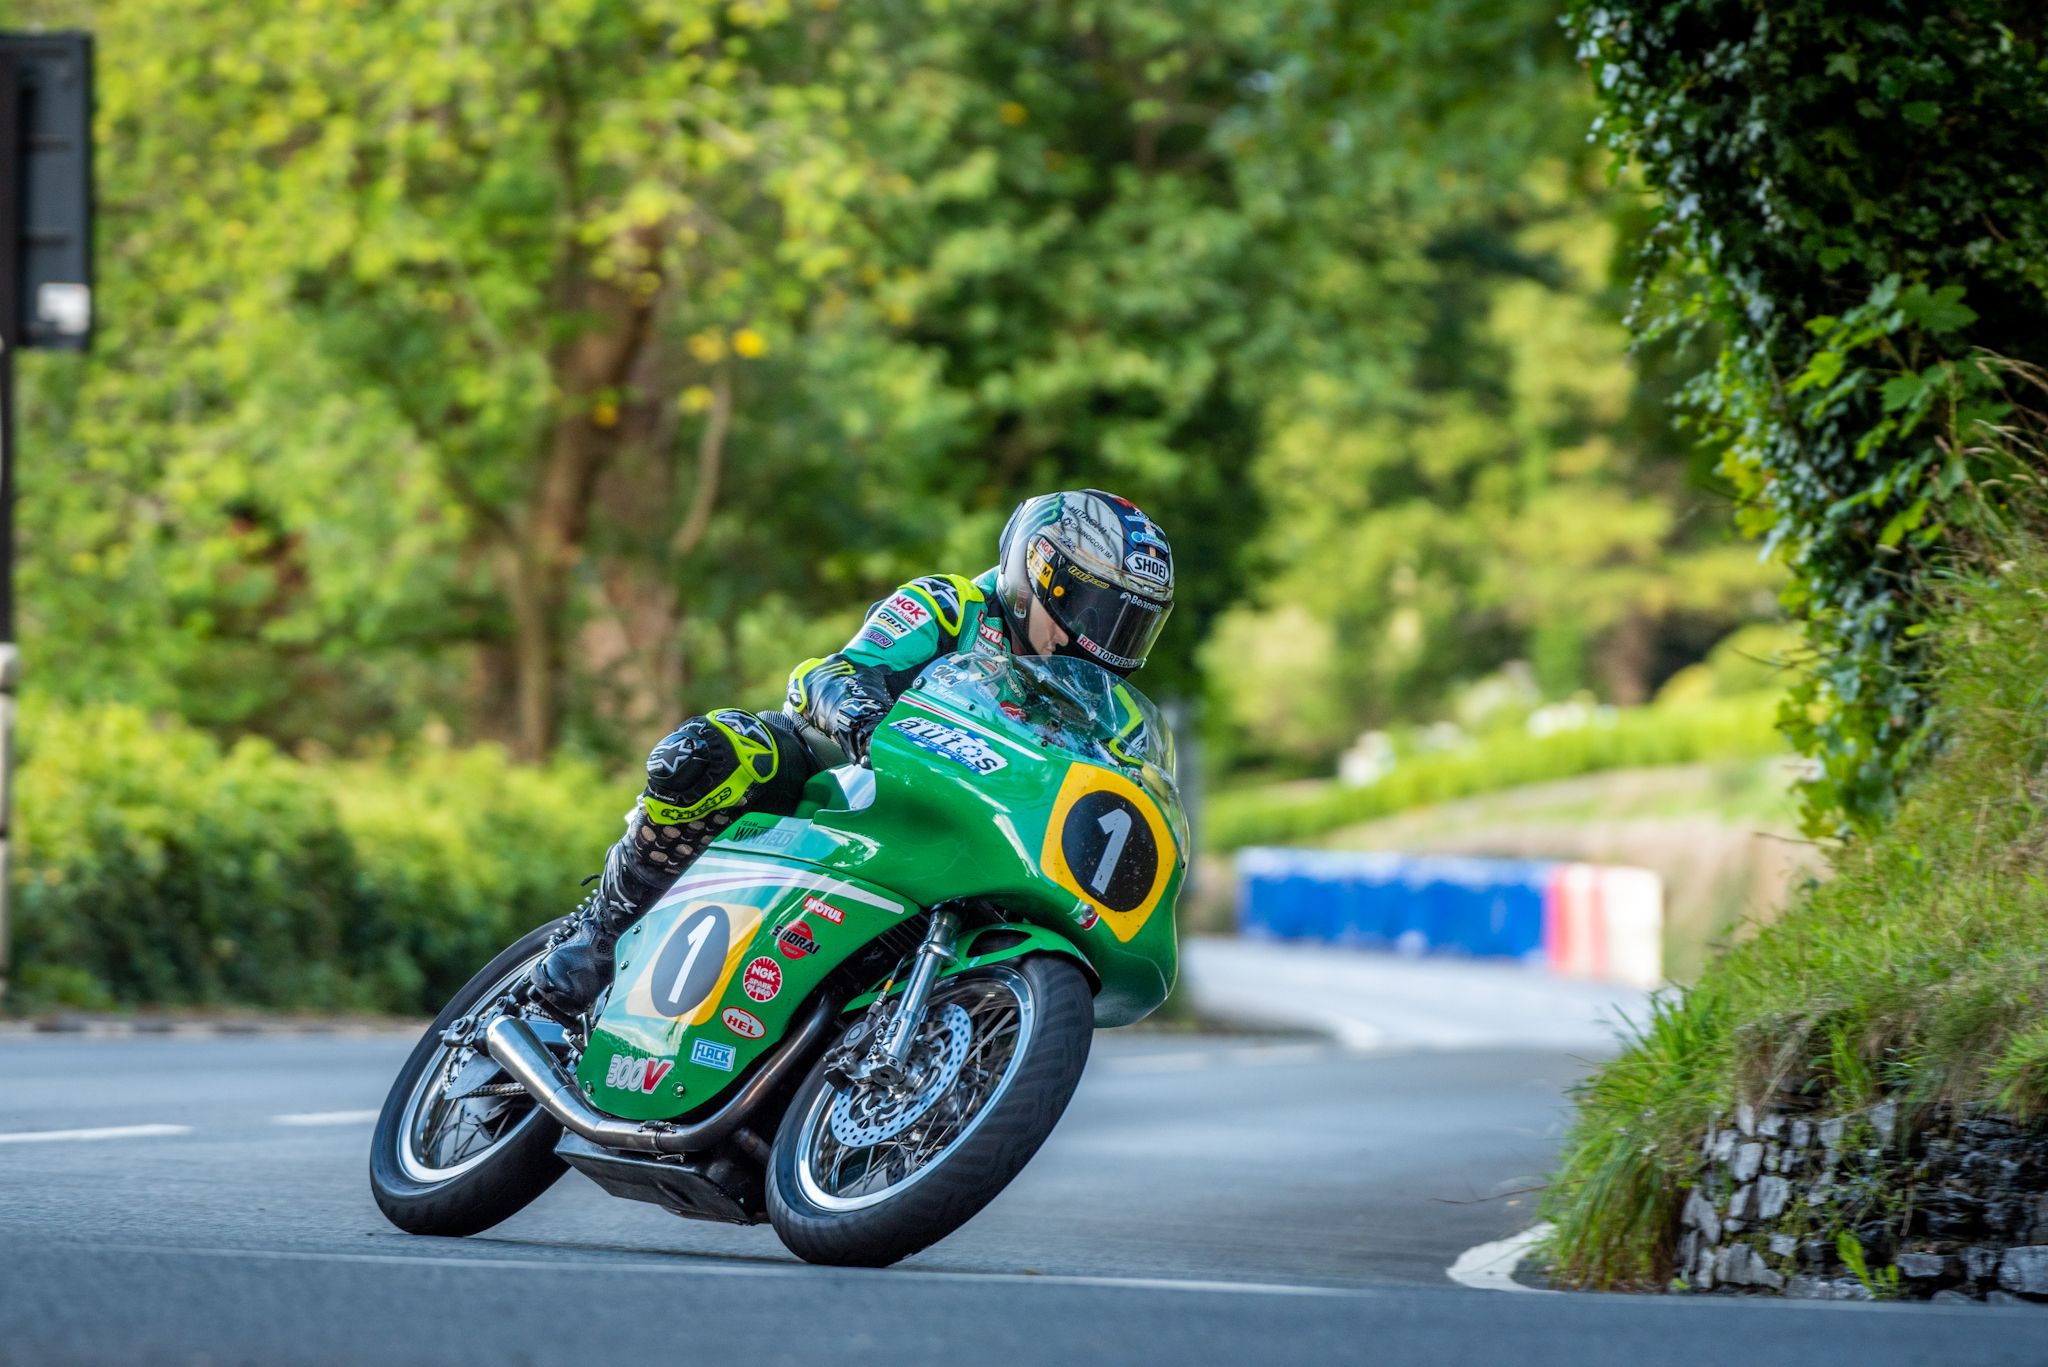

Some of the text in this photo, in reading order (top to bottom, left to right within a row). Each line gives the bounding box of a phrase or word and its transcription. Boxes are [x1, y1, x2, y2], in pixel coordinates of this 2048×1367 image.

[1039, 540, 1055, 558] NGK
[1135, 557, 1165, 580] SHOEI
[891, 597, 926, 620] NGK
[1131, 596, 1162, 613] Bennetts
[878, 612, 908, 633] GBM
[1080, 637, 1098, 652] RED
[918, 719, 958, 738] sussex
[897, 720, 998, 771] autos
[1090, 808, 1132, 895] 1
[804, 898, 842, 923] MOTUL
[772, 924, 821, 955] SHORAI
[668, 915, 716, 1004] 1
[749, 977, 773, 990] SPARK
[751, 964, 777, 982] NGK
[727, 1015, 756, 1036] HEL
[693, 1040, 731, 1063] FLACK
[606, 1054, 674, 1094] 300V
